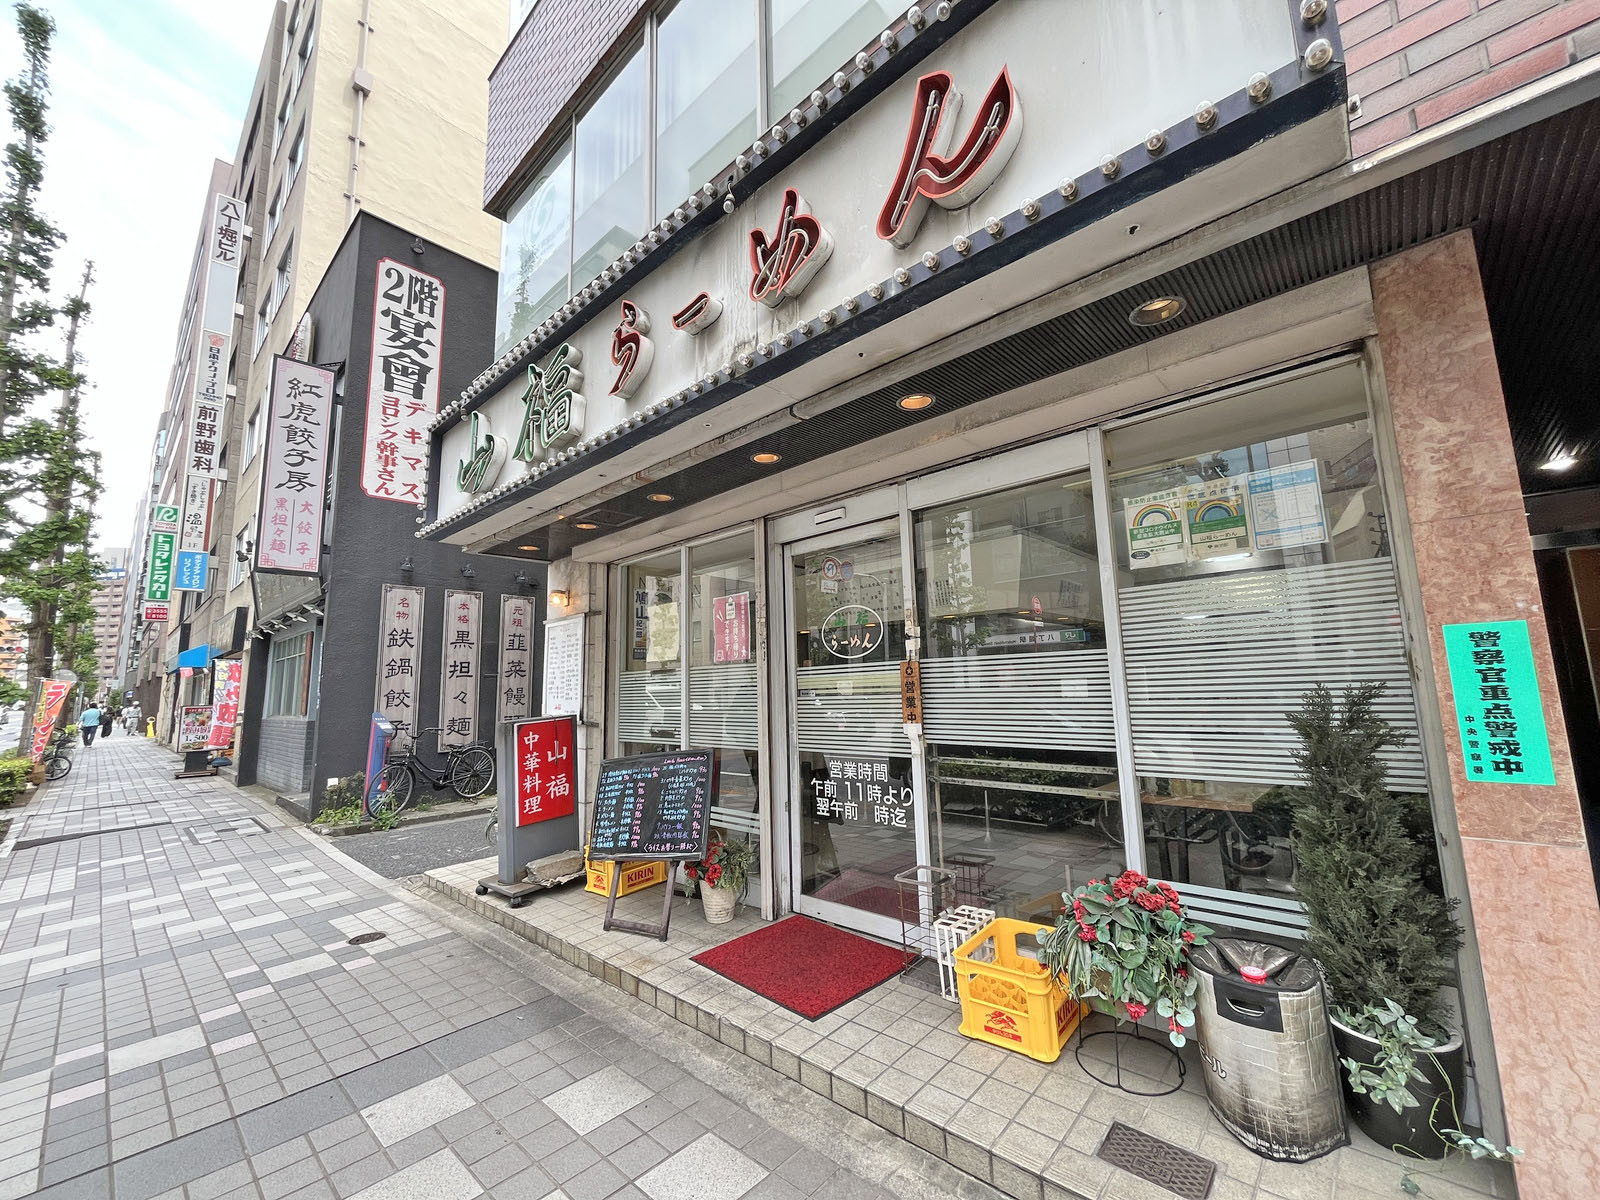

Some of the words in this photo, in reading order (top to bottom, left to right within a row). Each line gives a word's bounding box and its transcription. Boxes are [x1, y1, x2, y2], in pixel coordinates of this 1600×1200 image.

[215, 201, 241, 262] 八丁堀ビル
[192, 405, 219, 473] 前野歯科
[274, 377, 325, 494] 紅虎餃子房
[374, 394, 401, 497] ヨロシク幹事さん
[400, 401, 427, 500] デキマス
[269, 497, 288, 554] 黒担々麺
[296, 501, 314, 555] 大餃子
[152, 535, 171, 599] トヨタレンタカー
[395, 597, 410, 621] 名物
[457, 602, 470, 624] 本格
[511, 605, 524, 628] 元祖
[831, 632, 874, 651] らーめん
[446, 630, 475, 737] 黒担々麺
[905, 681, 917, 724] 営業中
[1467, 630, 1525, 775] 警察官重点警戒中
[523, 731, 543, 814] 中華料理
[546, 740, 570, 800] 山福
[810, 777, 838, 798] 午前
[829, 760, 888, 782] 営業時間
[816, 797, 858, 820] 翌午前
[874, 805, 907, 828] 時迄
[627, 866, 654, 883] KIRIN
